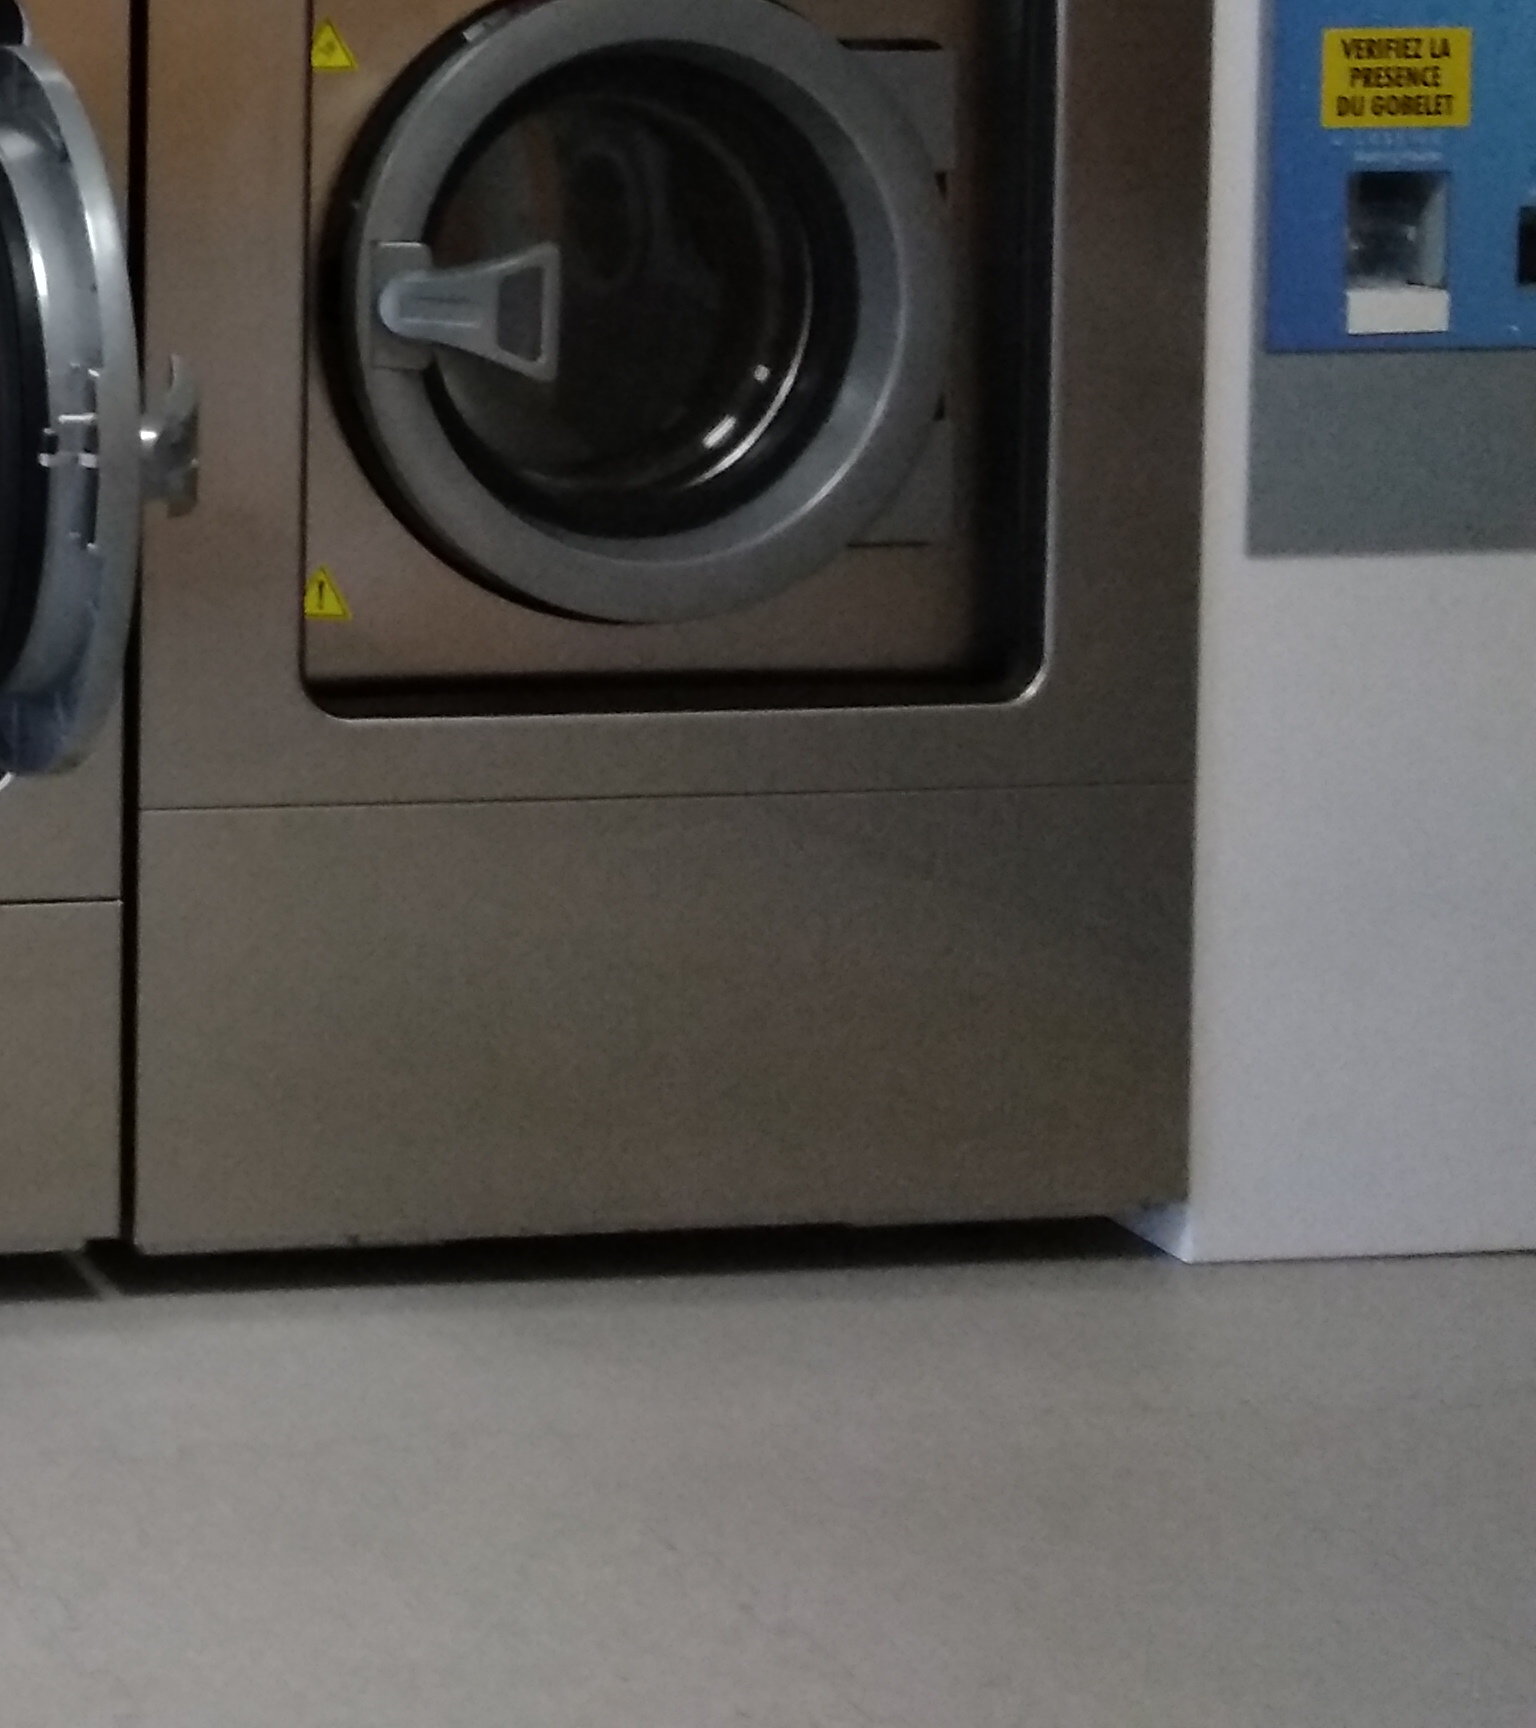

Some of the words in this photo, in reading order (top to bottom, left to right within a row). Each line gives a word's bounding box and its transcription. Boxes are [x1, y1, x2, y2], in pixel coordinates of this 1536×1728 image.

[1430, 38, 1451, 59] LA
[1336, 95, 1365, 117] DU
[1371, 94, 1454, 117] GOBELET
